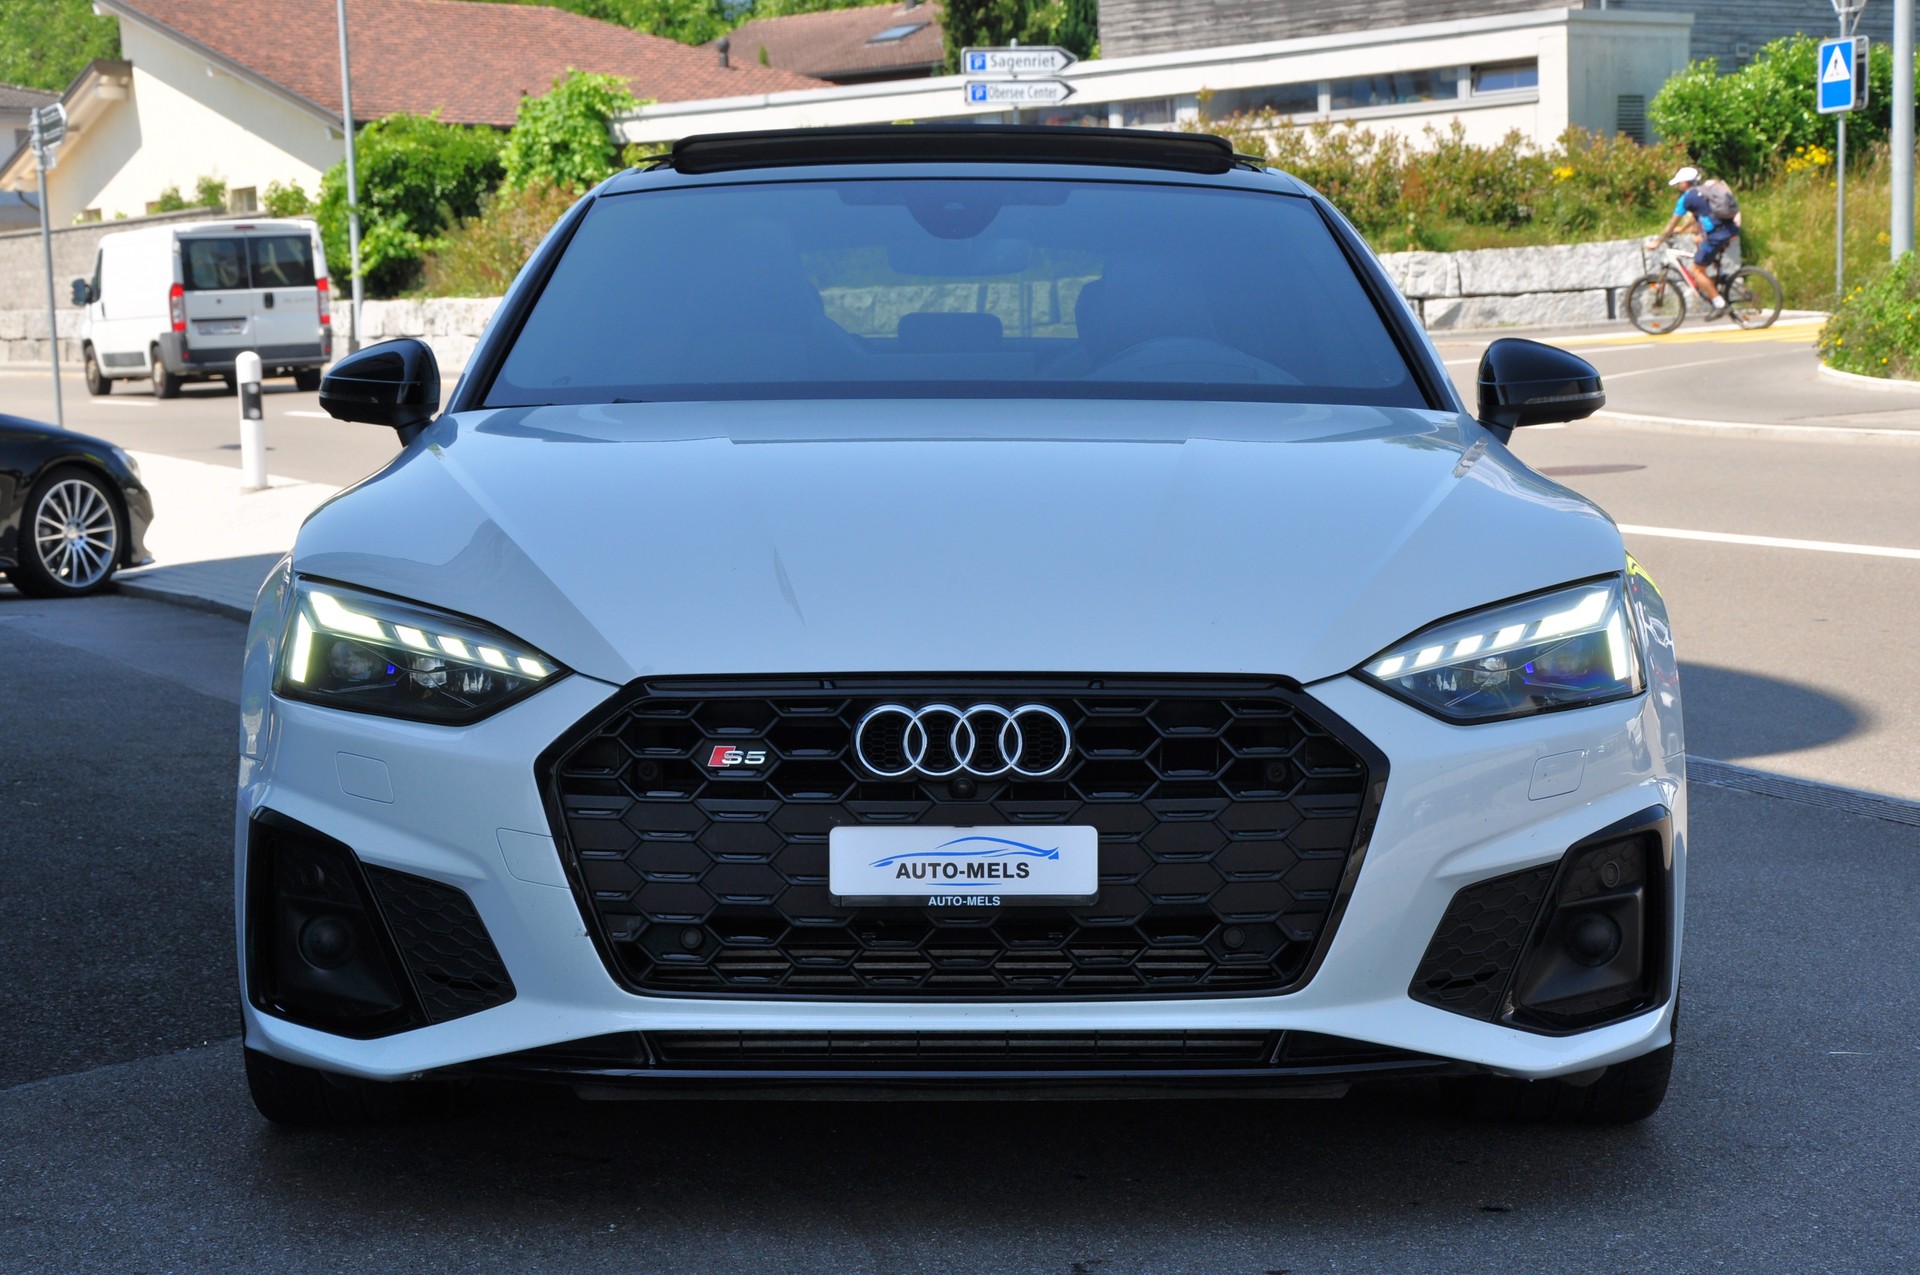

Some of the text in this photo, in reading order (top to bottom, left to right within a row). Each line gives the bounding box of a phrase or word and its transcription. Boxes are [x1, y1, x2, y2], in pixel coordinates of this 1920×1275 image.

[990, 54, 1055, 72] Sagenriet
[989, 85, 1025, 99] Obersee
[1027, 85, 1057, 99] Center
[721, 750, 767, 765] S5
[895, 862, 1030, 879] AUTO-MELS
[928, 896, 1001, 907] AUTO-MELS
